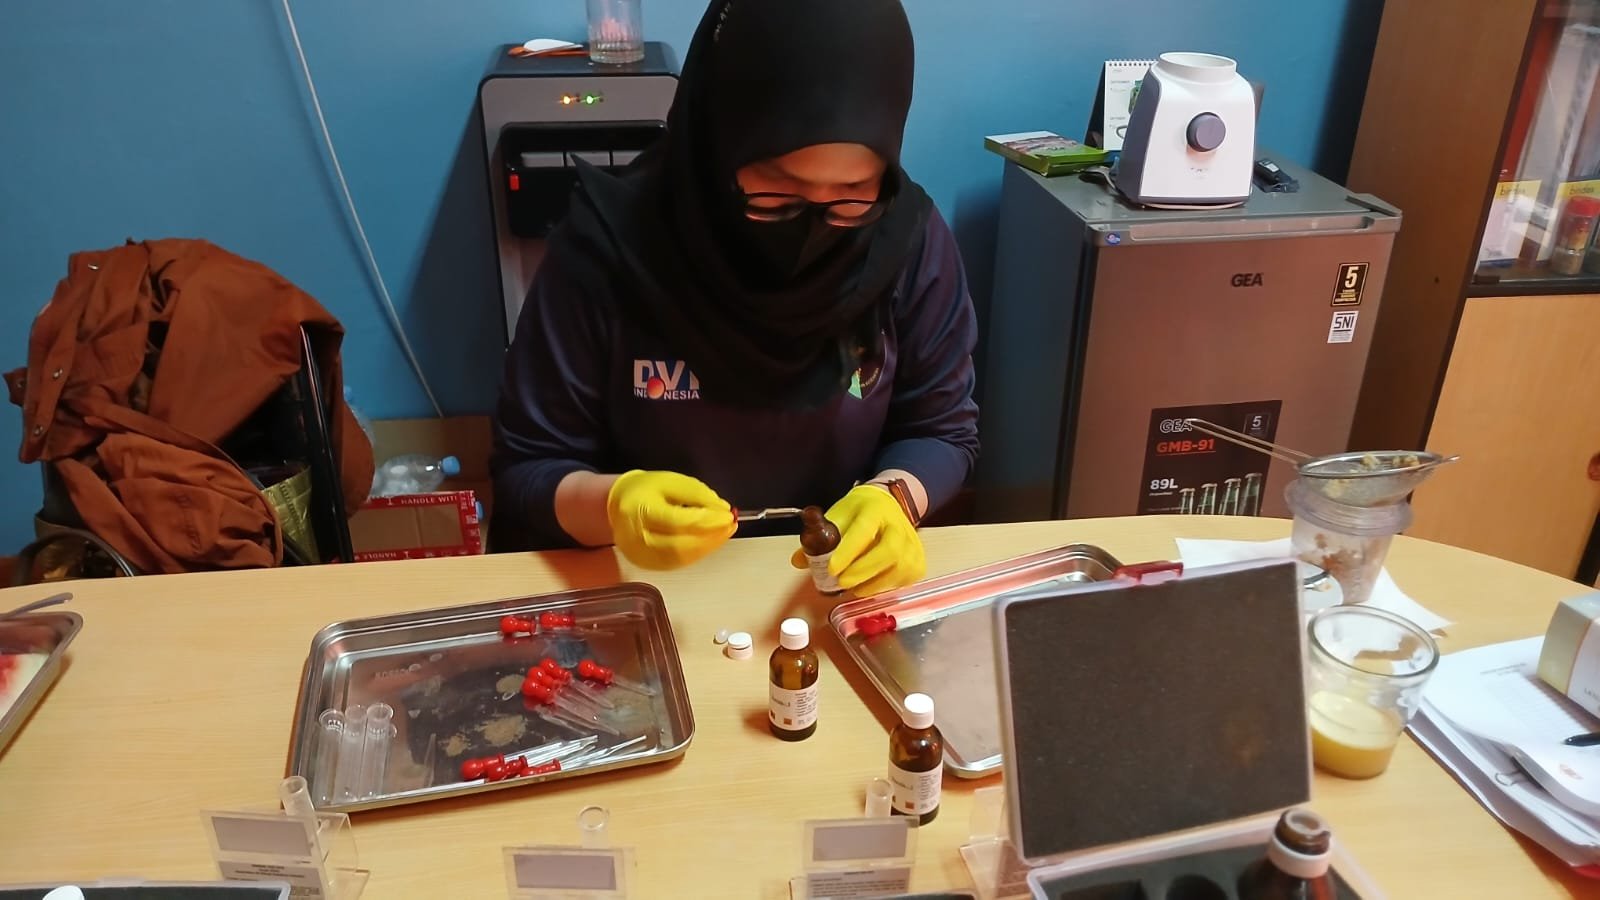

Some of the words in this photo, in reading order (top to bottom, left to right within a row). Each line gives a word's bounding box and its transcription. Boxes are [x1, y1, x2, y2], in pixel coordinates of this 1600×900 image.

[1231, 272, 1264, 288] GEA
[1344, 266, 1358, 288] 5
[1333, 315, 1355, 329] SNI
[1159, 417, 1193, 434] GEA
[1252, 415, 1262, 427] 5
[1156, 438, 1215, 453] GMB-91
[1150, 478, 1179, 490] 89L
[401, 497, 436, 505] HANDLE
